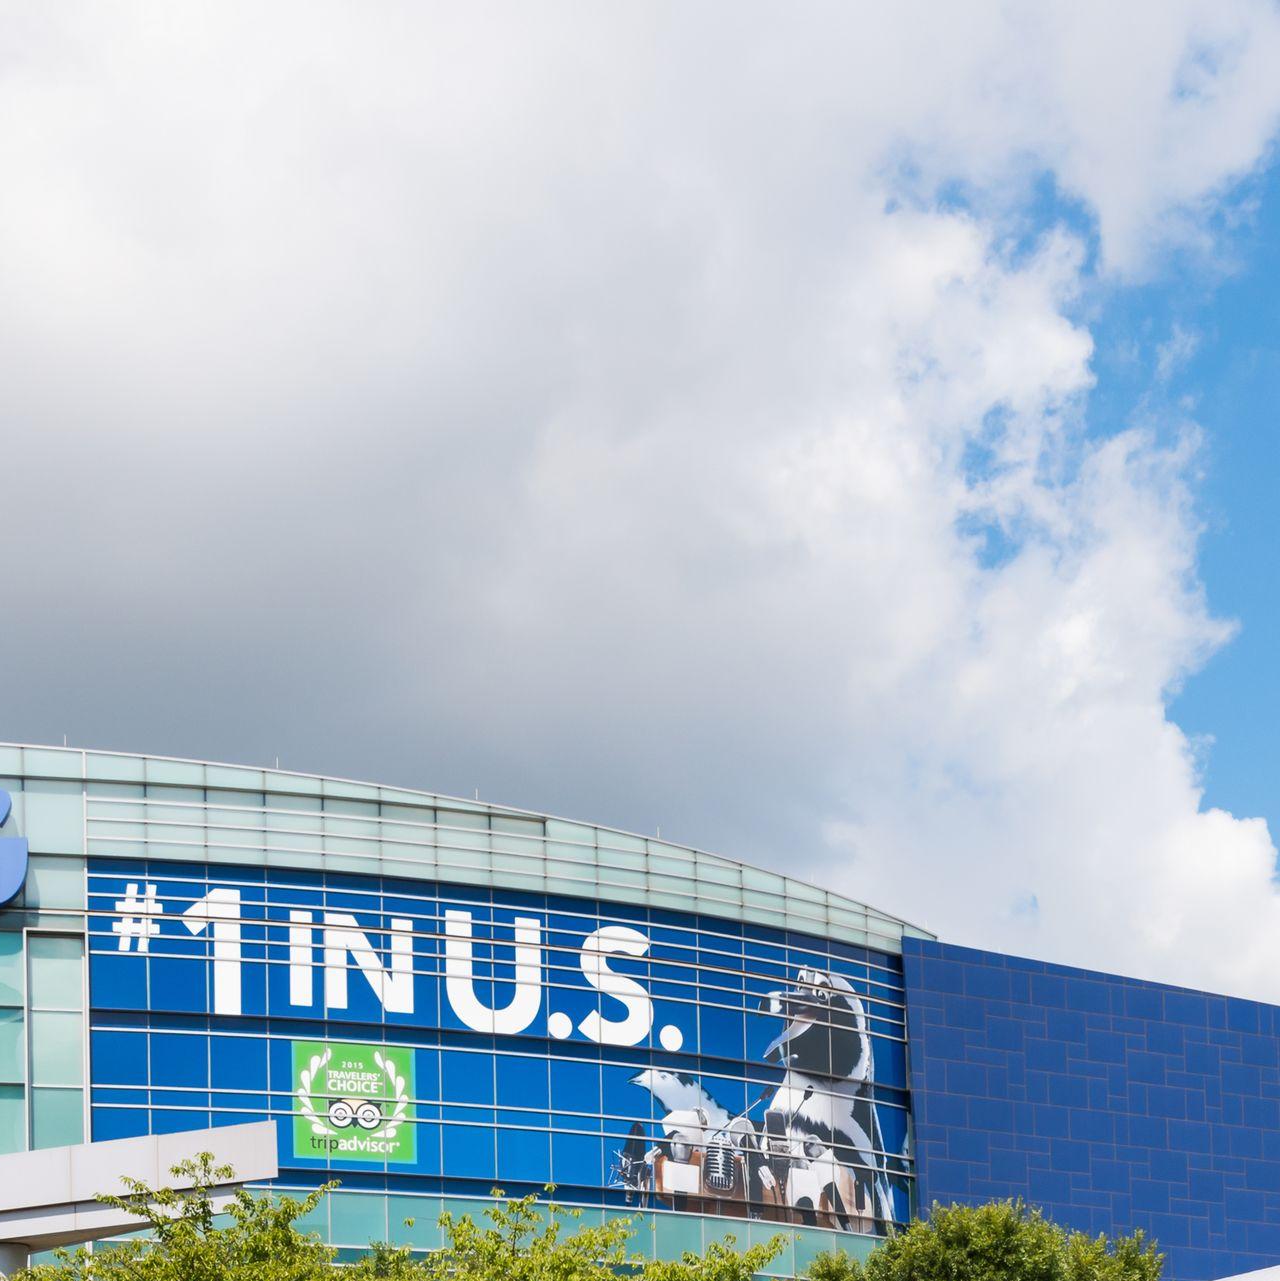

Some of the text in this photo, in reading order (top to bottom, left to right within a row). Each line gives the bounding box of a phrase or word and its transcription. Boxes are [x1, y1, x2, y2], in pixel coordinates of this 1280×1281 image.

[112, 883, 684, 1052] #1 IN U.S.
[341, 1061, 364, 1069] 2015
[327, 1080, 379, 1093] CHOICE
[310, 1135, 397, 1153] tripadvisor
